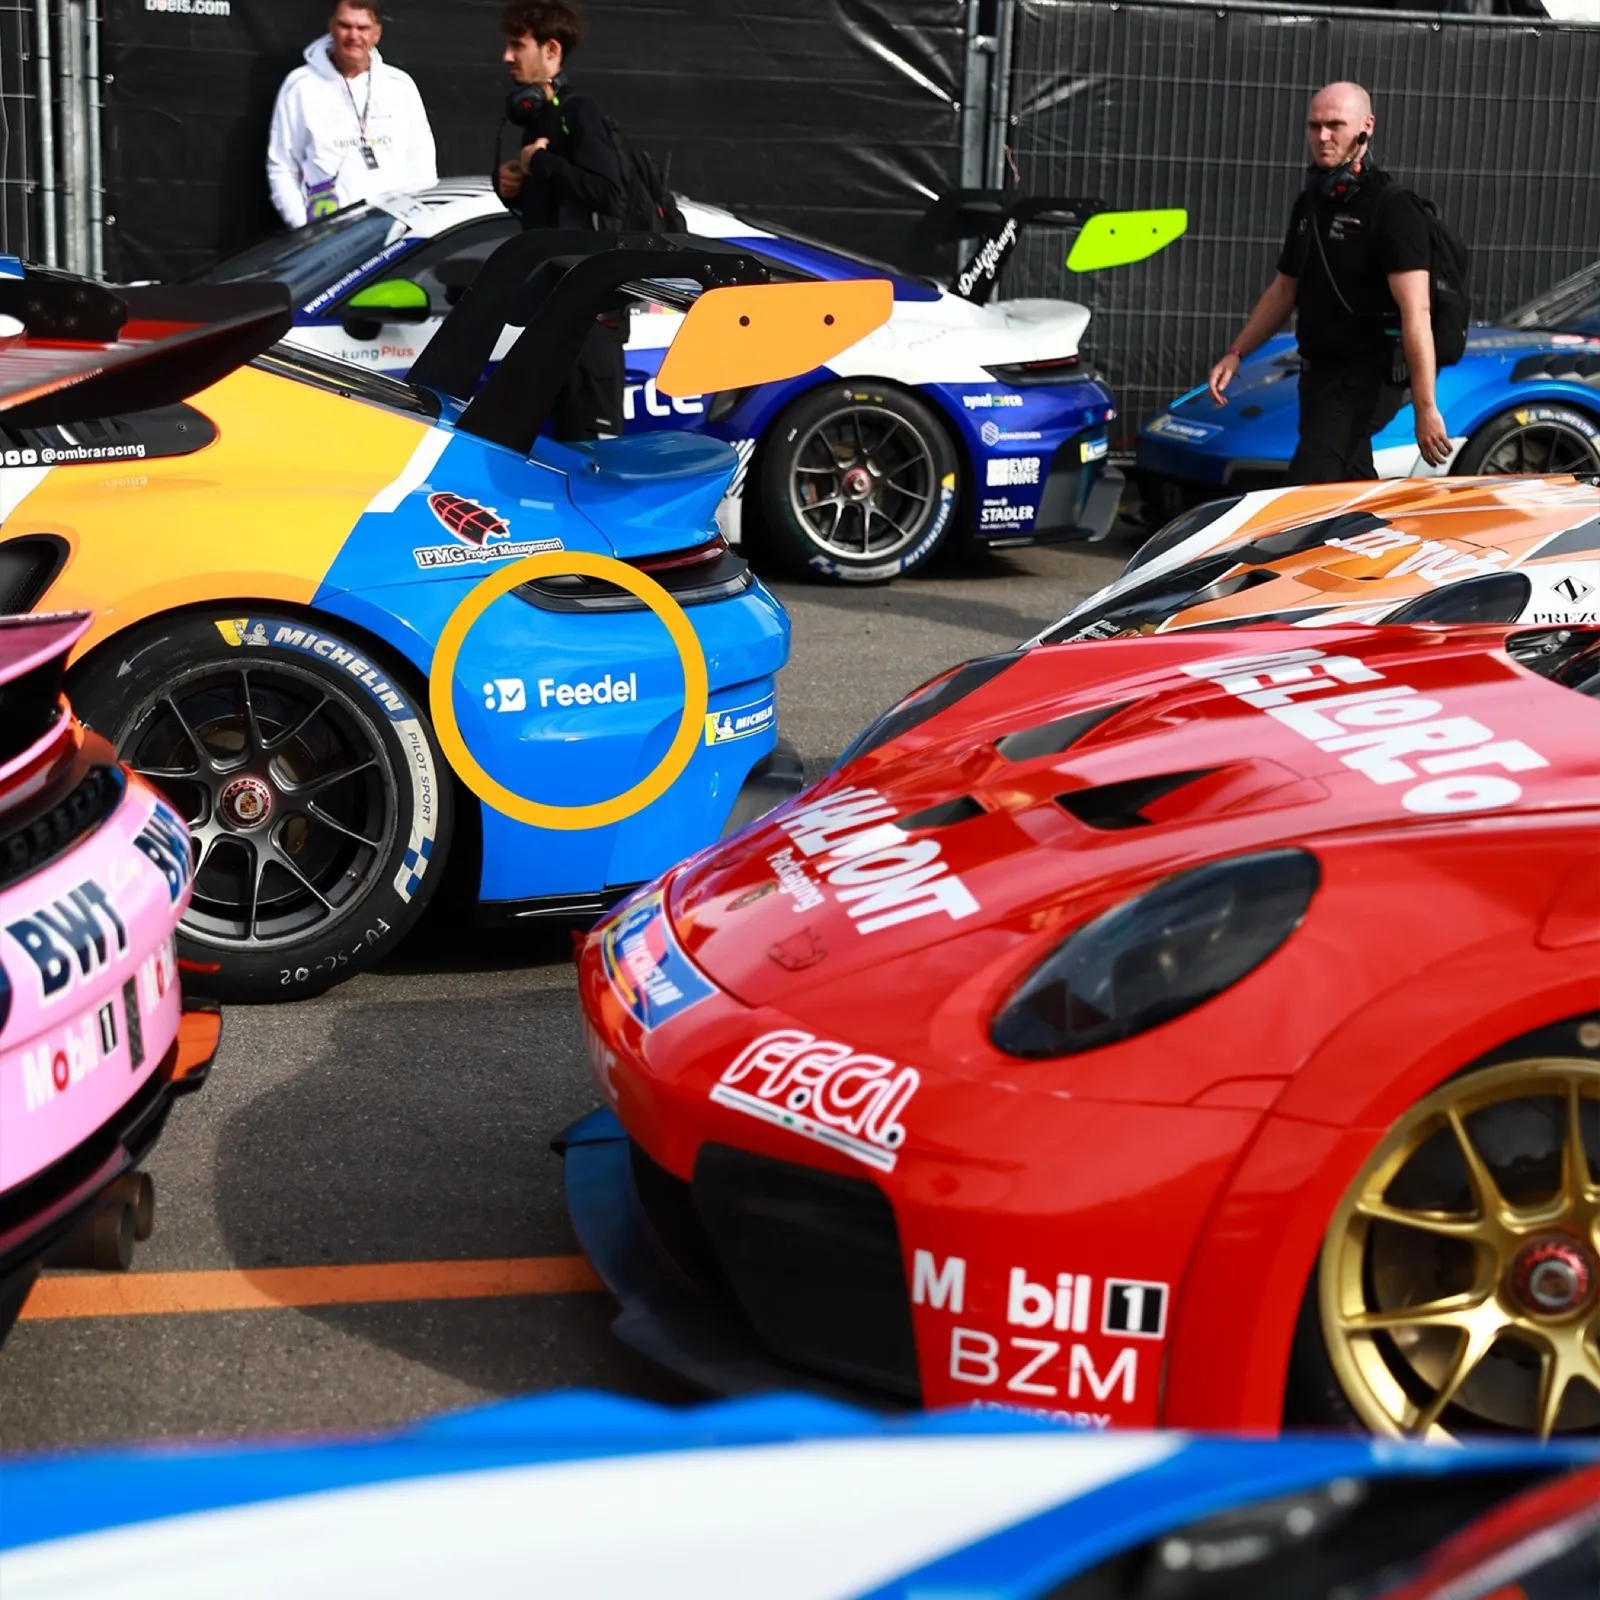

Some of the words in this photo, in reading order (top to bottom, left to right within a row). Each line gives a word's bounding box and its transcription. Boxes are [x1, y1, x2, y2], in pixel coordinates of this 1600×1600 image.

[333, 345, 415, 361] kungPlus
[41, 444, 146, 464] @ombraracing
[1009, 457, 1041, 473] EVER
[1009, 471, 1040, 486] NINE
[981, 505, 1035, 523] STADLER
[416, 548, 464, 567] IPMG
[464, 546, 499, 562] Project
[499, 540, 563, 556] Management
[274, 626, 405, 712] MICHELIN
[538, 673, 637, 708] Feedel
[408, 732, 428, 771] PILOT
[421, 776, 431, 824] SPORT
[766, 847, 826, 914] Packaging
[776, 786, 981, 935] VALMONT
[4, 879, 127, 999] BWT
[621, 933, 685, 1007] MICHELIN
[950, 1326, 1138, 1404] BZM
